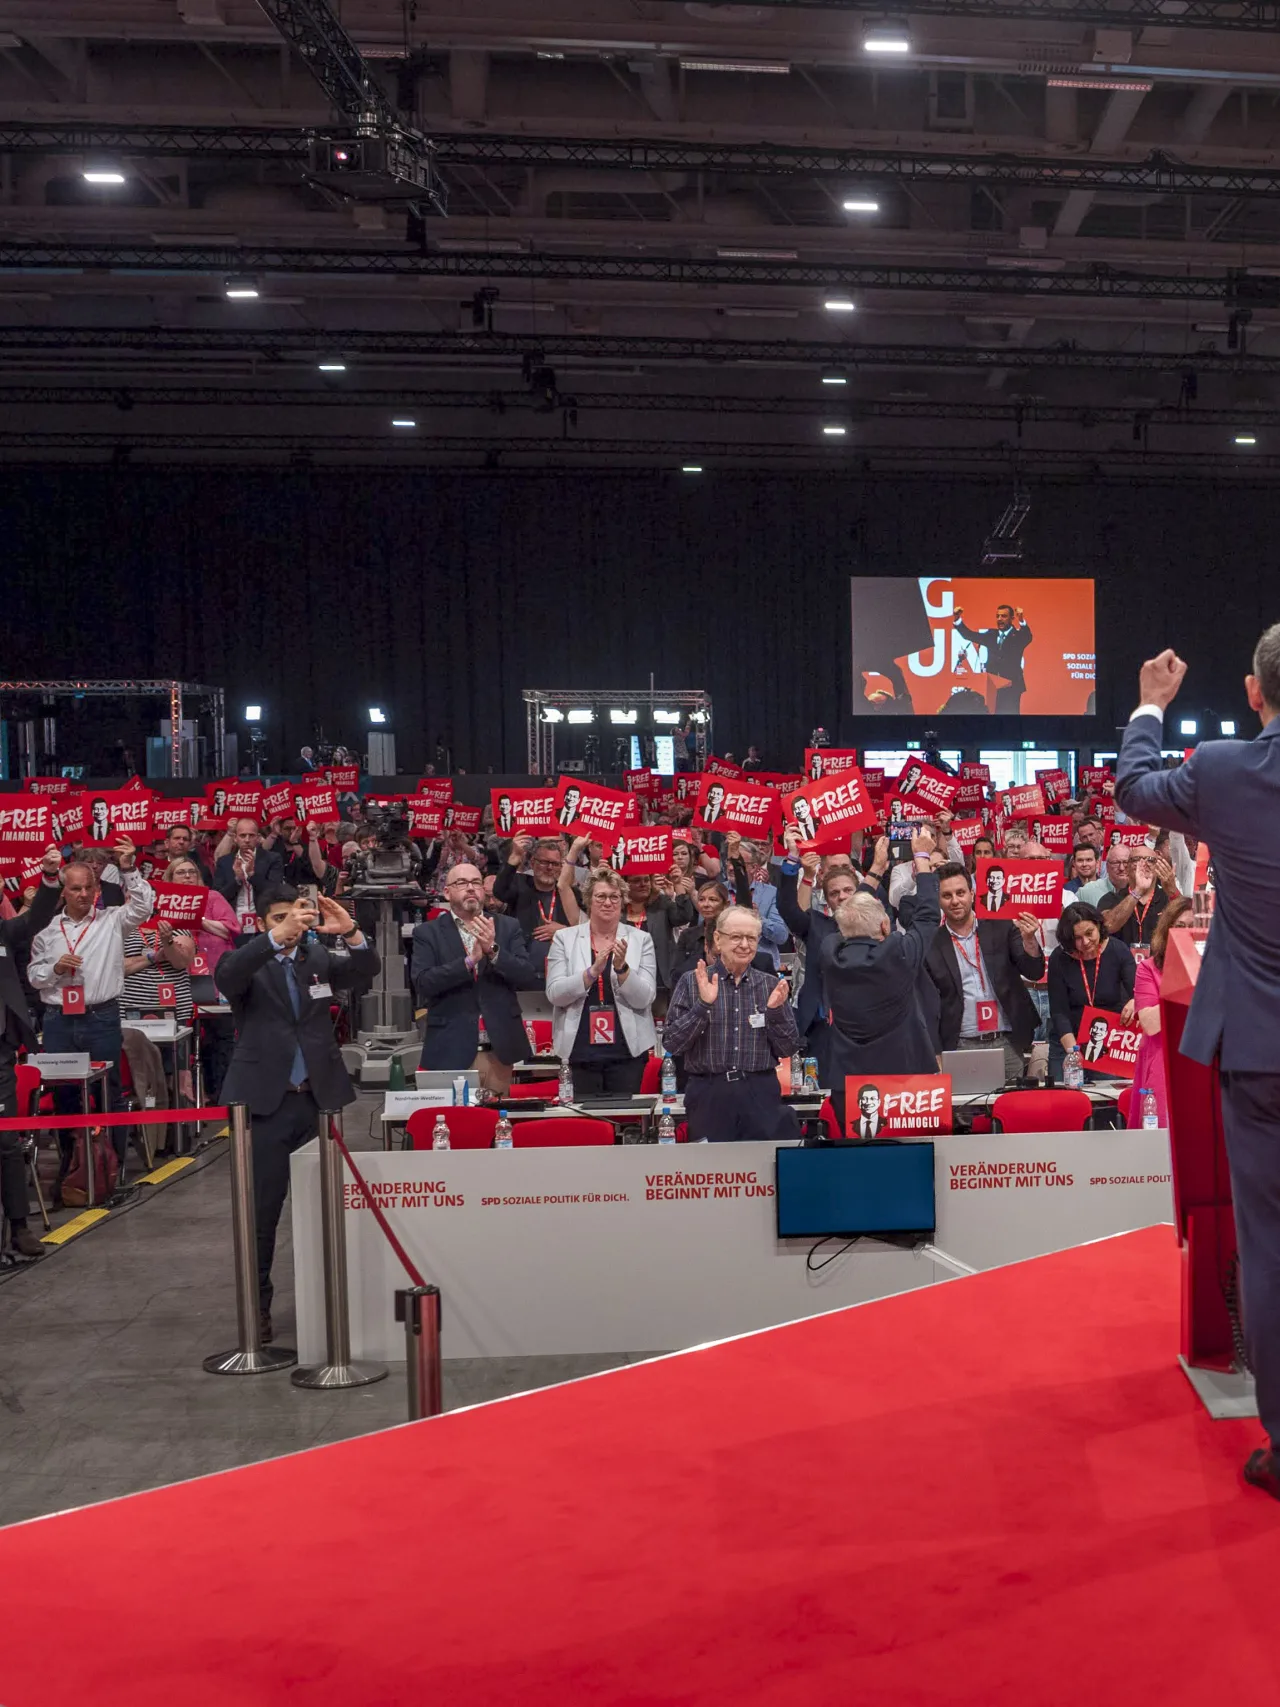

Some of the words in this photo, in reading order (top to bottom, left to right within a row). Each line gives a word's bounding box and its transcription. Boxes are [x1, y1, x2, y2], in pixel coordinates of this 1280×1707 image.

[1066, 662, 1093, 670] SOZIALE
[1071, 671, 1083, 680] FÜR
[1084, 672, 1096, 680] DIC
[823, 756, 854, 769] FREE
[333, 770, 356, 781] FREE
[631, 772, 650, 784] FREE
[717, 764, 740, 779] FREE
[862, 772, 882, 782] FREE
[970, 768, 988, 777] FREE
[40, 783, 67, 794] FREE
[776, 780, 800, 793] FREE
[918, 774, 955, 798] FREE
[1054, 778, 1070, 790] FREE
[226, 792, 260, 806] FREE
[263, 788, 290, 810] FREE
[304, 792, 332, 809] FREE
[724, 793, 772, 814] FREE
[811, 779, 860, 817] FREE
[916, 788, 944, 808] IMAMOGLU
[1012, 790, 1039, 805] FREE
[111, 800, 148, 822] FREE
[310, 806, 332, 815] IMAMOGLU
[513, 798, 554, 816] FREE
[579, 795, 624, 818] FREE
[1016, 801, 1038, 810] IMAMOGLU
[1104, 806, 1114, 815] FR
[0, 806, 48, 830] FREE
[60, 806, 83, 827] FRE
[154, 810, 188, 824] FREE
[416, 813, 440, 824] FREE
[454, 812, 479, 822] FREE
[581, 813, 616, 830] IMAMOGLU
[726, 811, 763, 825] IMAMOGLU
[822, 803, 863, 826] IMAMOGLU
[116, 822, 146, 832] IMAMOGLU
[954, 824, 981, 839] FREE
[1042, 822, 1070, 837] FREE
[2, 831, 45, 842] IMAMOGLU
[1044, 837, 1067, 845] IMAMOGLU
[627, 834, 668, 855] FREE
[632, 853, 666, 862] IMAMOGLU
[1007, 872, 1058, 894] FREE
[157, 894, 204, 910] FREE
[1011, 894, 1052, 904] IMAMOGLU
[160, 910, 196, 920] IMAMOGLU
[245, 916, 254, 926] D
[194, 957, 204, 968] D
[1135, 953, 1144, 964] D
[68, 991, 79, 1004] D
[162, 988, 173, 1000] D
[981, 1006, 992, 1020] D
[1108, 1028, 1142, 1050] FRE
[1110, 1048, 1137, 1063] IMAMO
[883, 1087, 945, 1118] FREE
[890, 1116, 940, 1130] IMAMOGLU
[950, 1162, 1057, 1176] VERÄNDERUNG
[645, 1172, 757, 1187] VERÄNDERUNG
[950, 1177, 1012, 1190] BEGINNT
[1016, 1176, 1042, 1188] MIT
[1045, 1174, 1074, 1186] UNS
[1090, 1176, 1108, 1185] SPD
[1109, 1175, 1144, 1184] SOZIALE
[1146, 1174, 1172, 1183] POLIT
[344, 1180, 446, 1196] ERNDERUNG
[646, 1186, 709, 1200] BEGINNT
[714, 1186, 740, 1198] MIT
[745, 1184, 776, 1198] UNS
[344, 1196, 398, 1210] EGINT
[402, 1196, 430, 1208] MIT
[434, 1194, 464, 1207] UNS
[481, 1197, 500, 1206] SPD
[502, 1196, 542, 1205] SOZIALE
[544, 1194, 580, 1204] POLITIK
[582, 1193, 600, 1202] FÜR
[604, 1194, 630, 1202] DICH.
